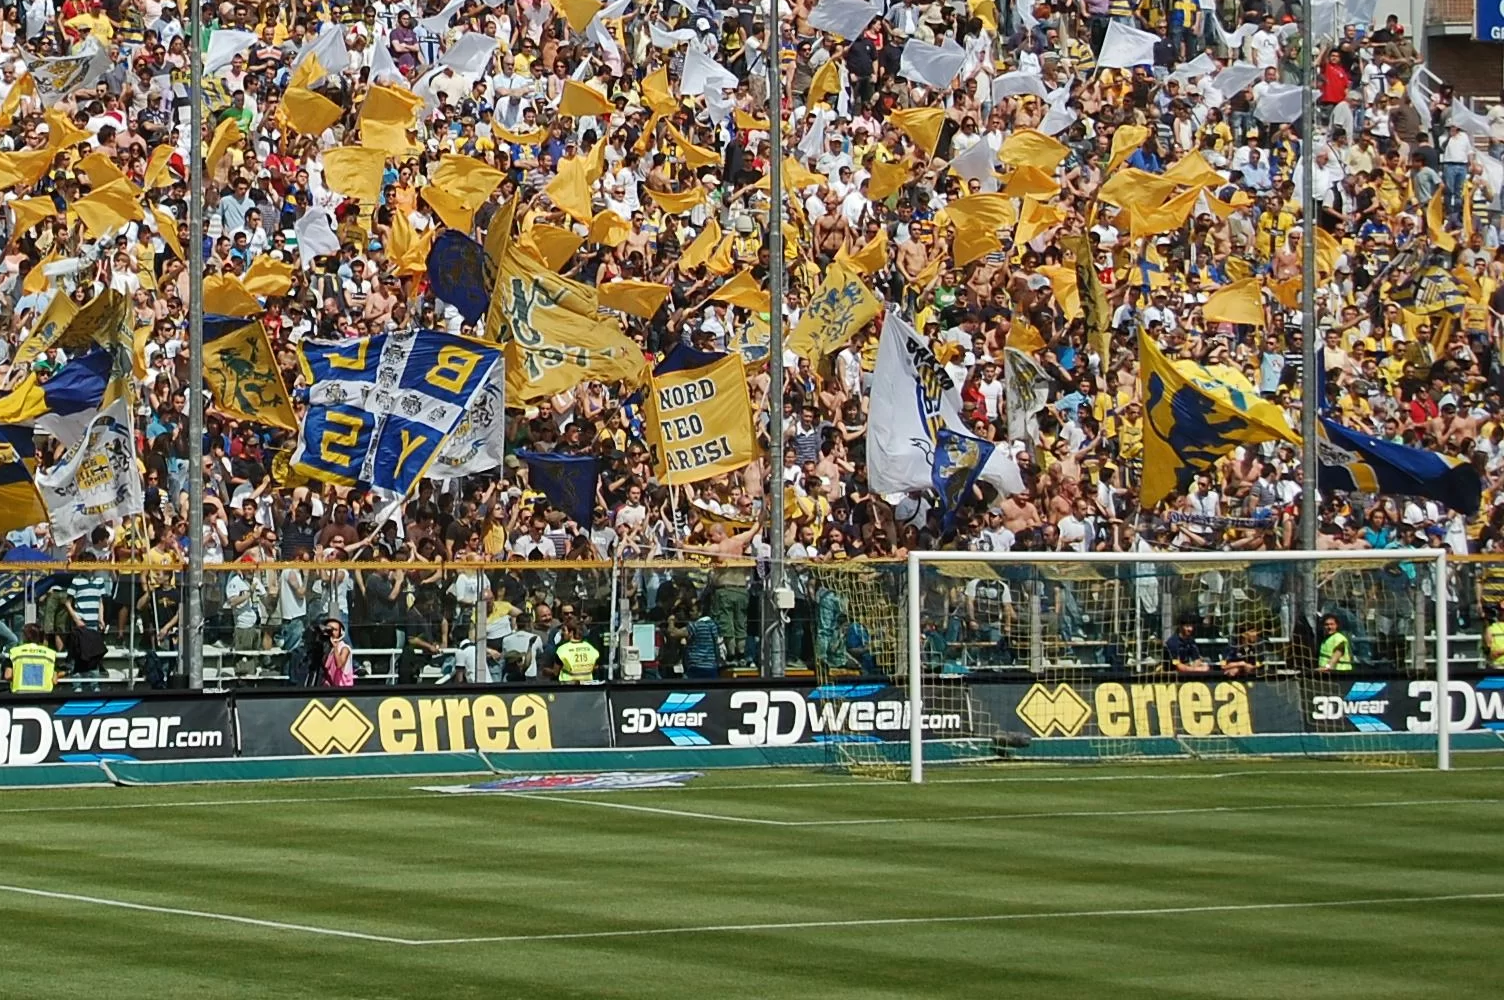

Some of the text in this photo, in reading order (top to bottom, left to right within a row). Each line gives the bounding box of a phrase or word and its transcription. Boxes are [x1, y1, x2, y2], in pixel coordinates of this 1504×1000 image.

[659, 378, 715, 410] NORD
[378, 694, 553, 752] errea
[621, 708, 707, 734] 3Dwear
[727, 690, 960, 746] 3Dwearcom
